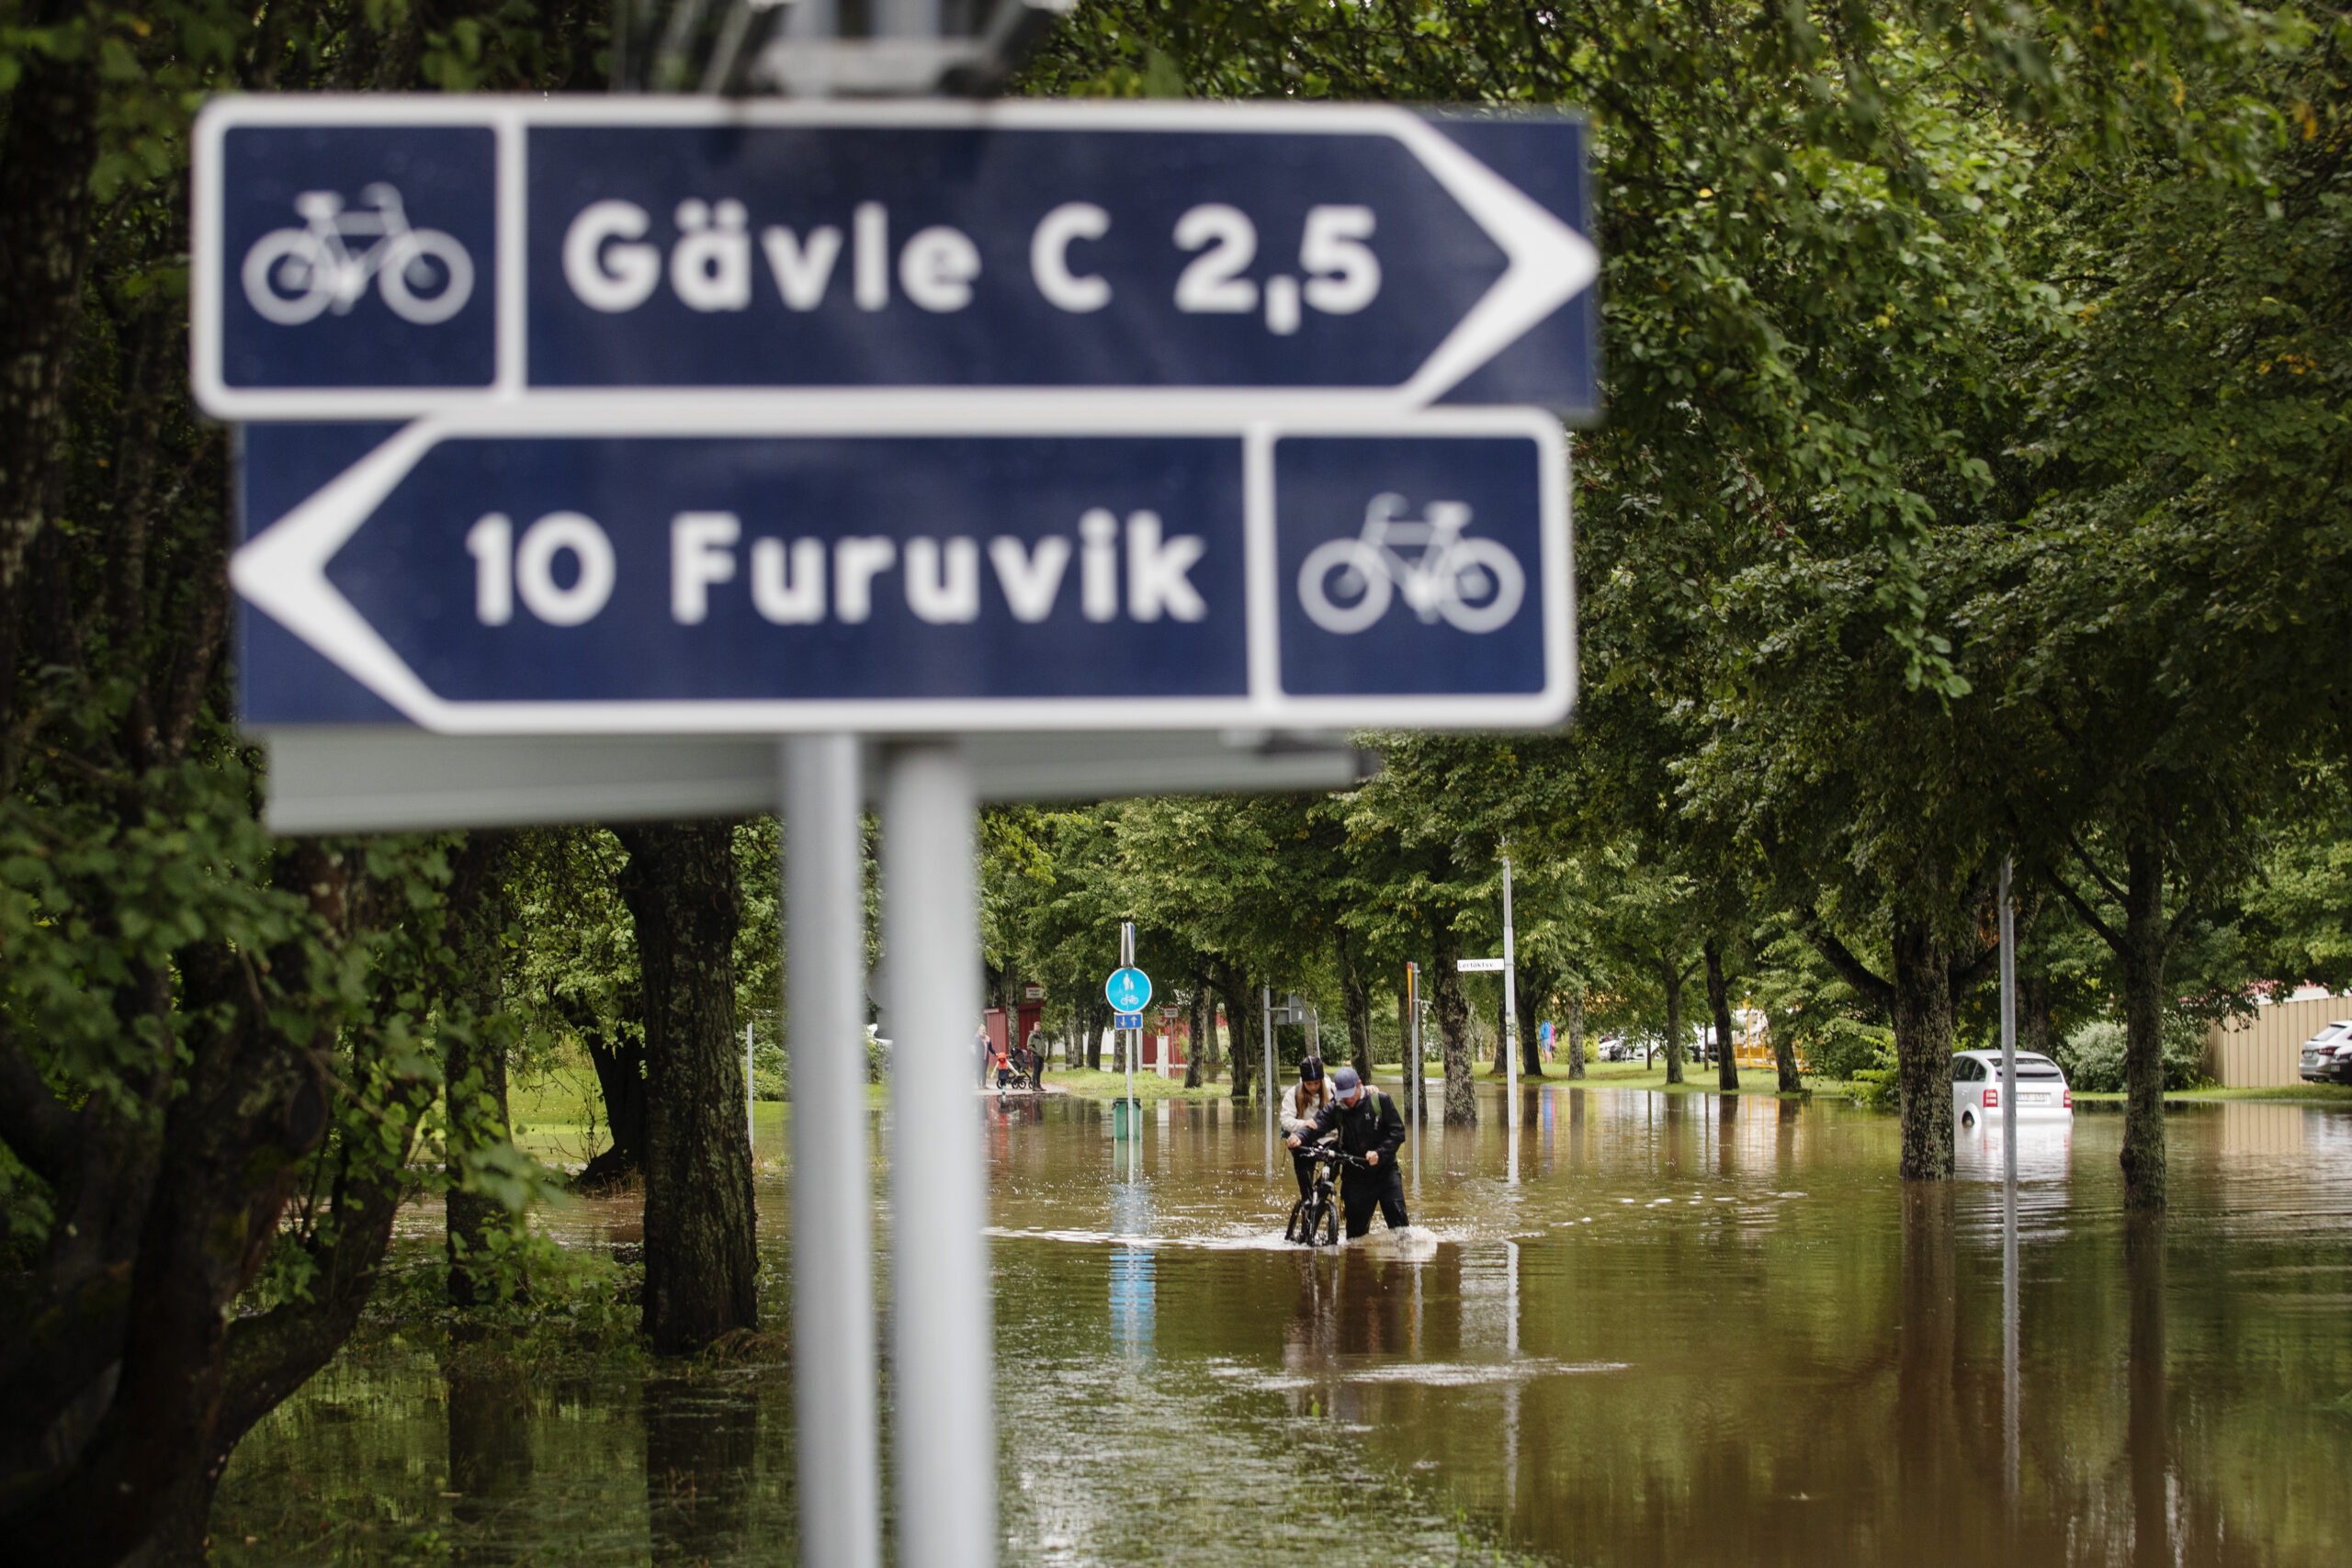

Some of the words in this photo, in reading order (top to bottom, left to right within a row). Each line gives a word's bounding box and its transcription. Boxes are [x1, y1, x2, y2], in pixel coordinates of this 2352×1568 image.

[562, 199, 981, 312] Gävle
[1031, 203, 1111, 312] C
[1174, 204, 1382, 334] 2,5
[467, 512, 616, 626] 10
[671, 508, 1206, 626] Furuvik
